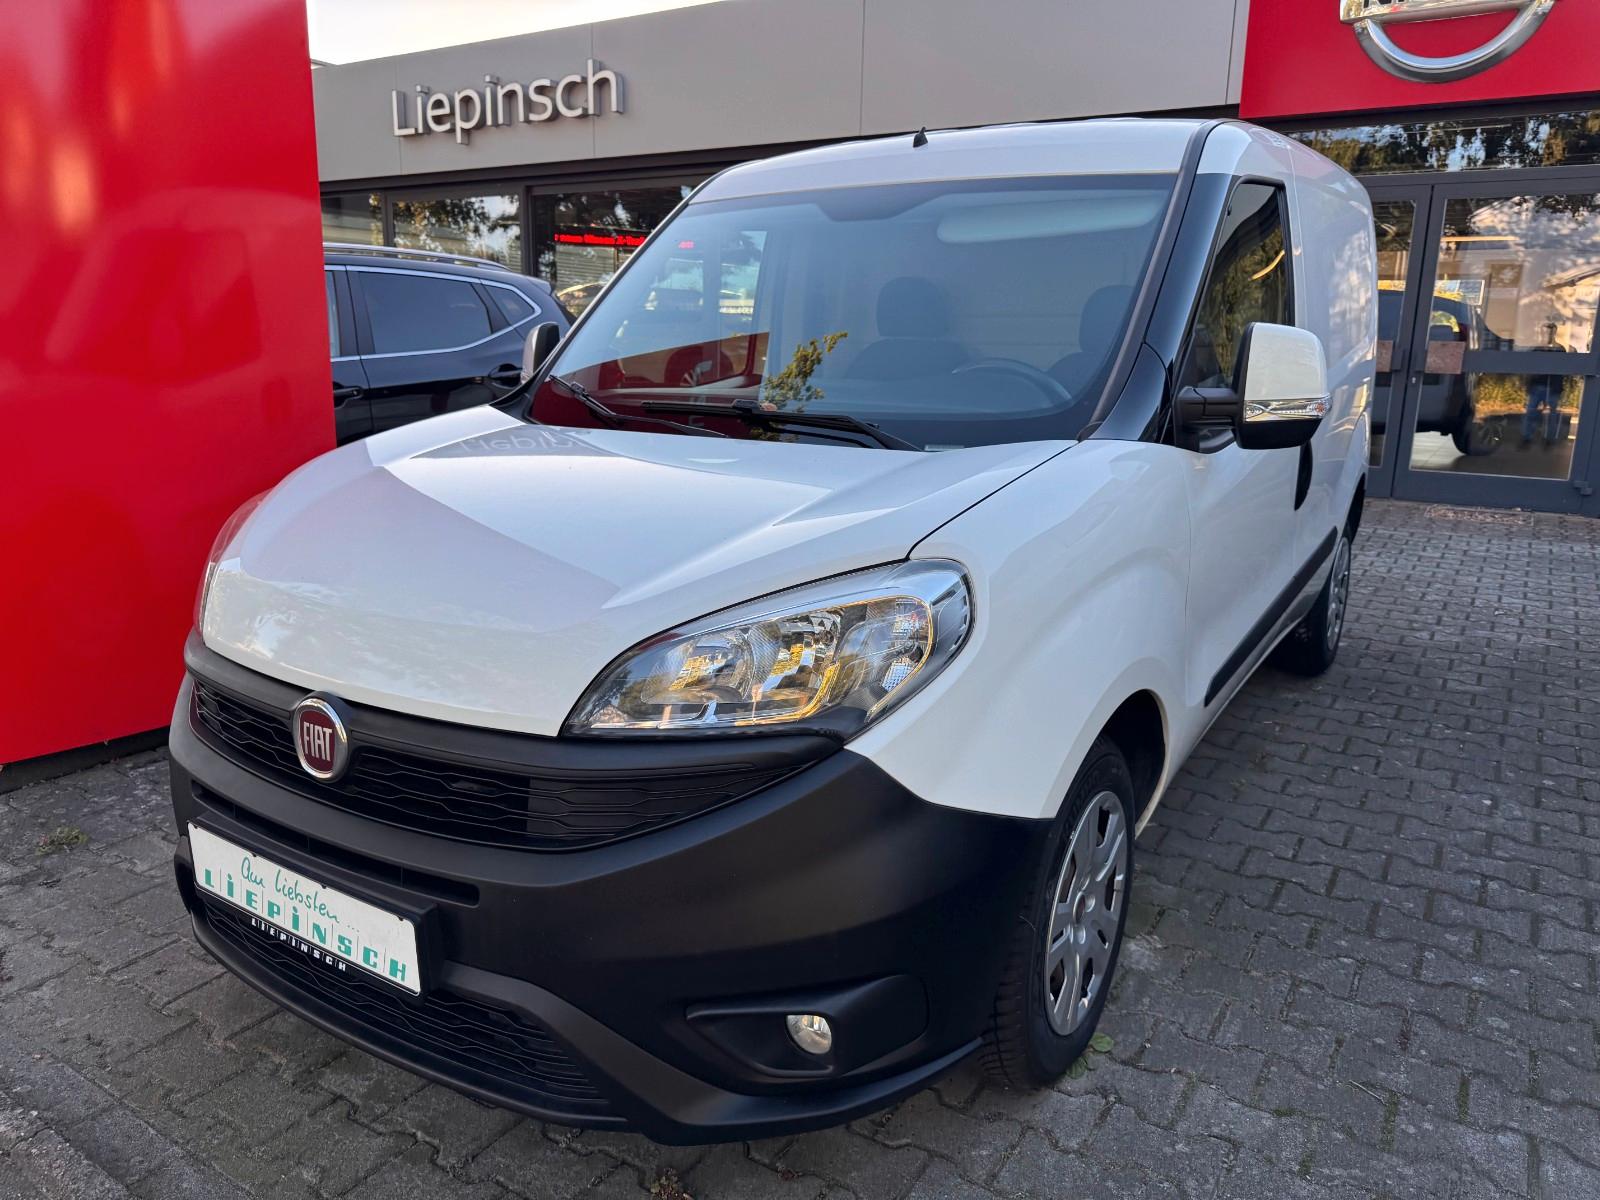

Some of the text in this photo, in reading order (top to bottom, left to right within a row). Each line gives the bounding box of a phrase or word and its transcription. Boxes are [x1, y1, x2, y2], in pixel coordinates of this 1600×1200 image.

[391, 58, 624, 145] Liepinsch
[303, 721, 333, 761] FIAT
[275, 869, 340, 923] liebsten
